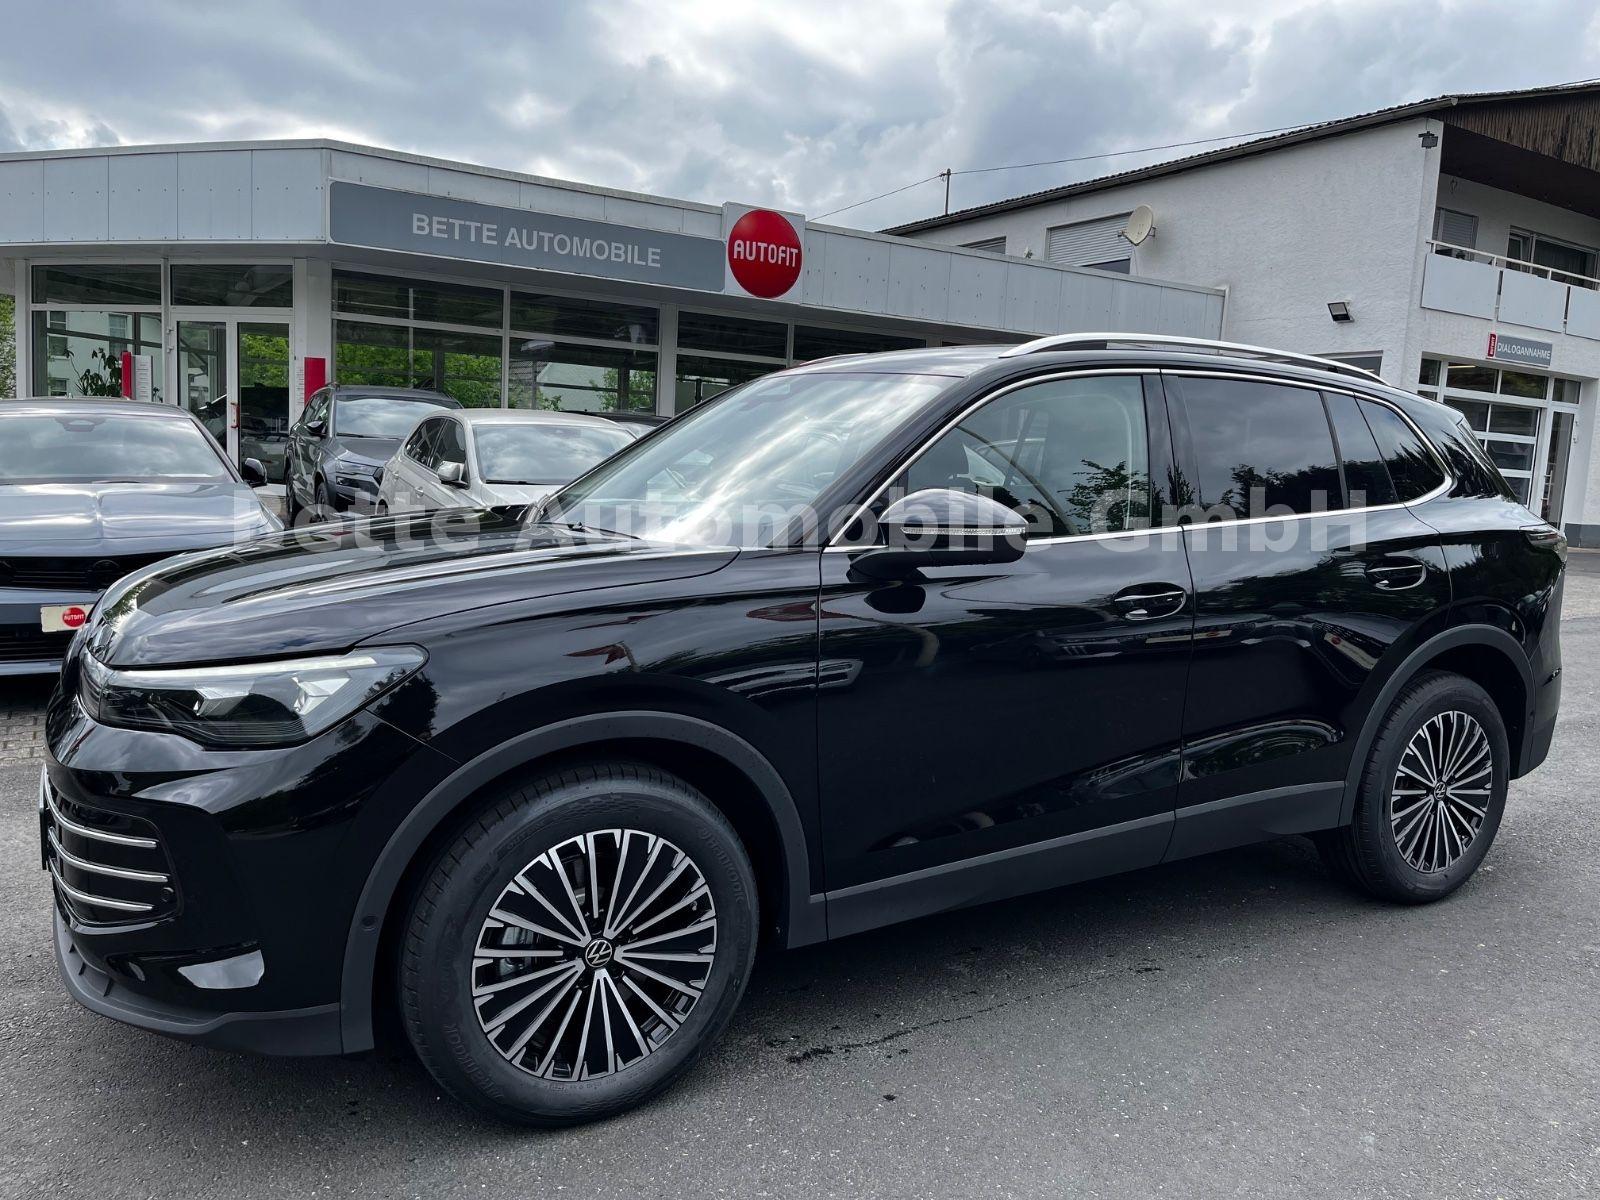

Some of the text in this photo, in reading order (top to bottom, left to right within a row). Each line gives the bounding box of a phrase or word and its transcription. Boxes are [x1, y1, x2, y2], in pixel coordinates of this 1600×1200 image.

[411, 213, 661, 268] BETTE AUTOMOBILE
[733, 239, 799, 267] AUTOFIT
[1497, 343, 1551, 359] DIALOGANNAHME
